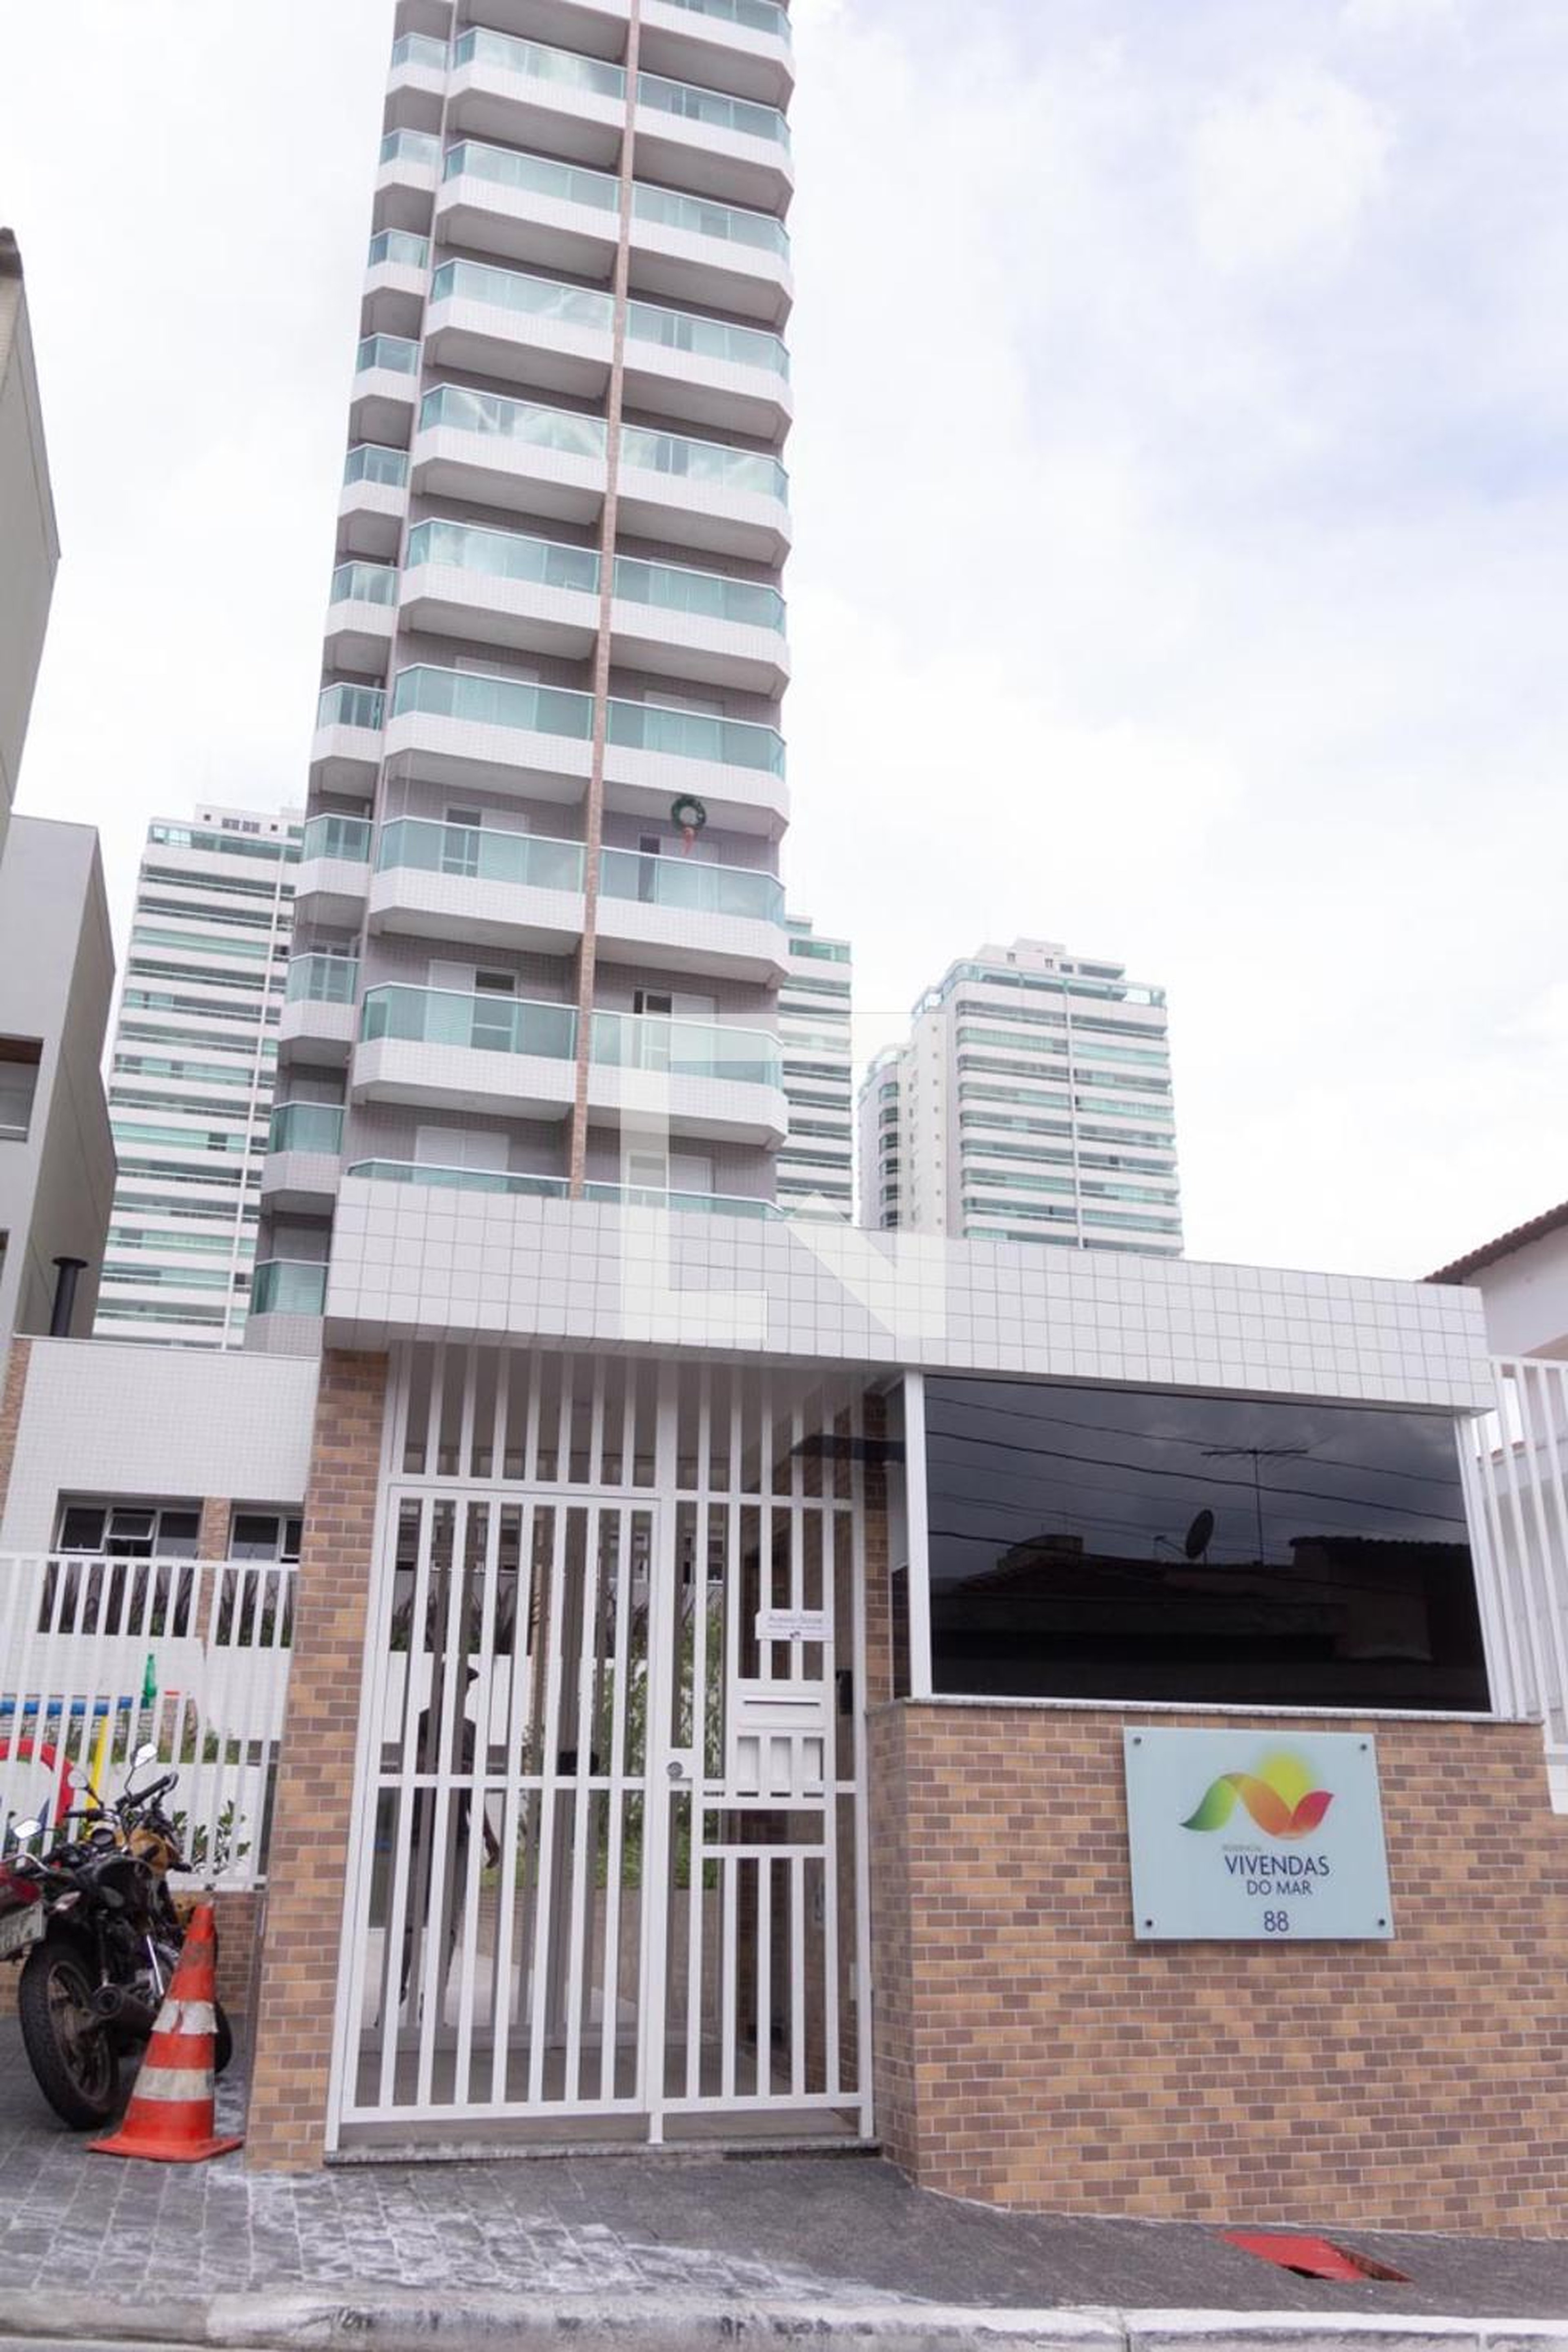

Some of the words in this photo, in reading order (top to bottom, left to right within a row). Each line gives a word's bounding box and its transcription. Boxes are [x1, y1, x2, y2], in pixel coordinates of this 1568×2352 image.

[1225, 1855, 1330, 1875] VIVENDAS
[1247, 1879, 1272, 1895] DO
[1276, 1880, 1313, 1895] MAR
[1264, 1911, 1289, 1932] 88
